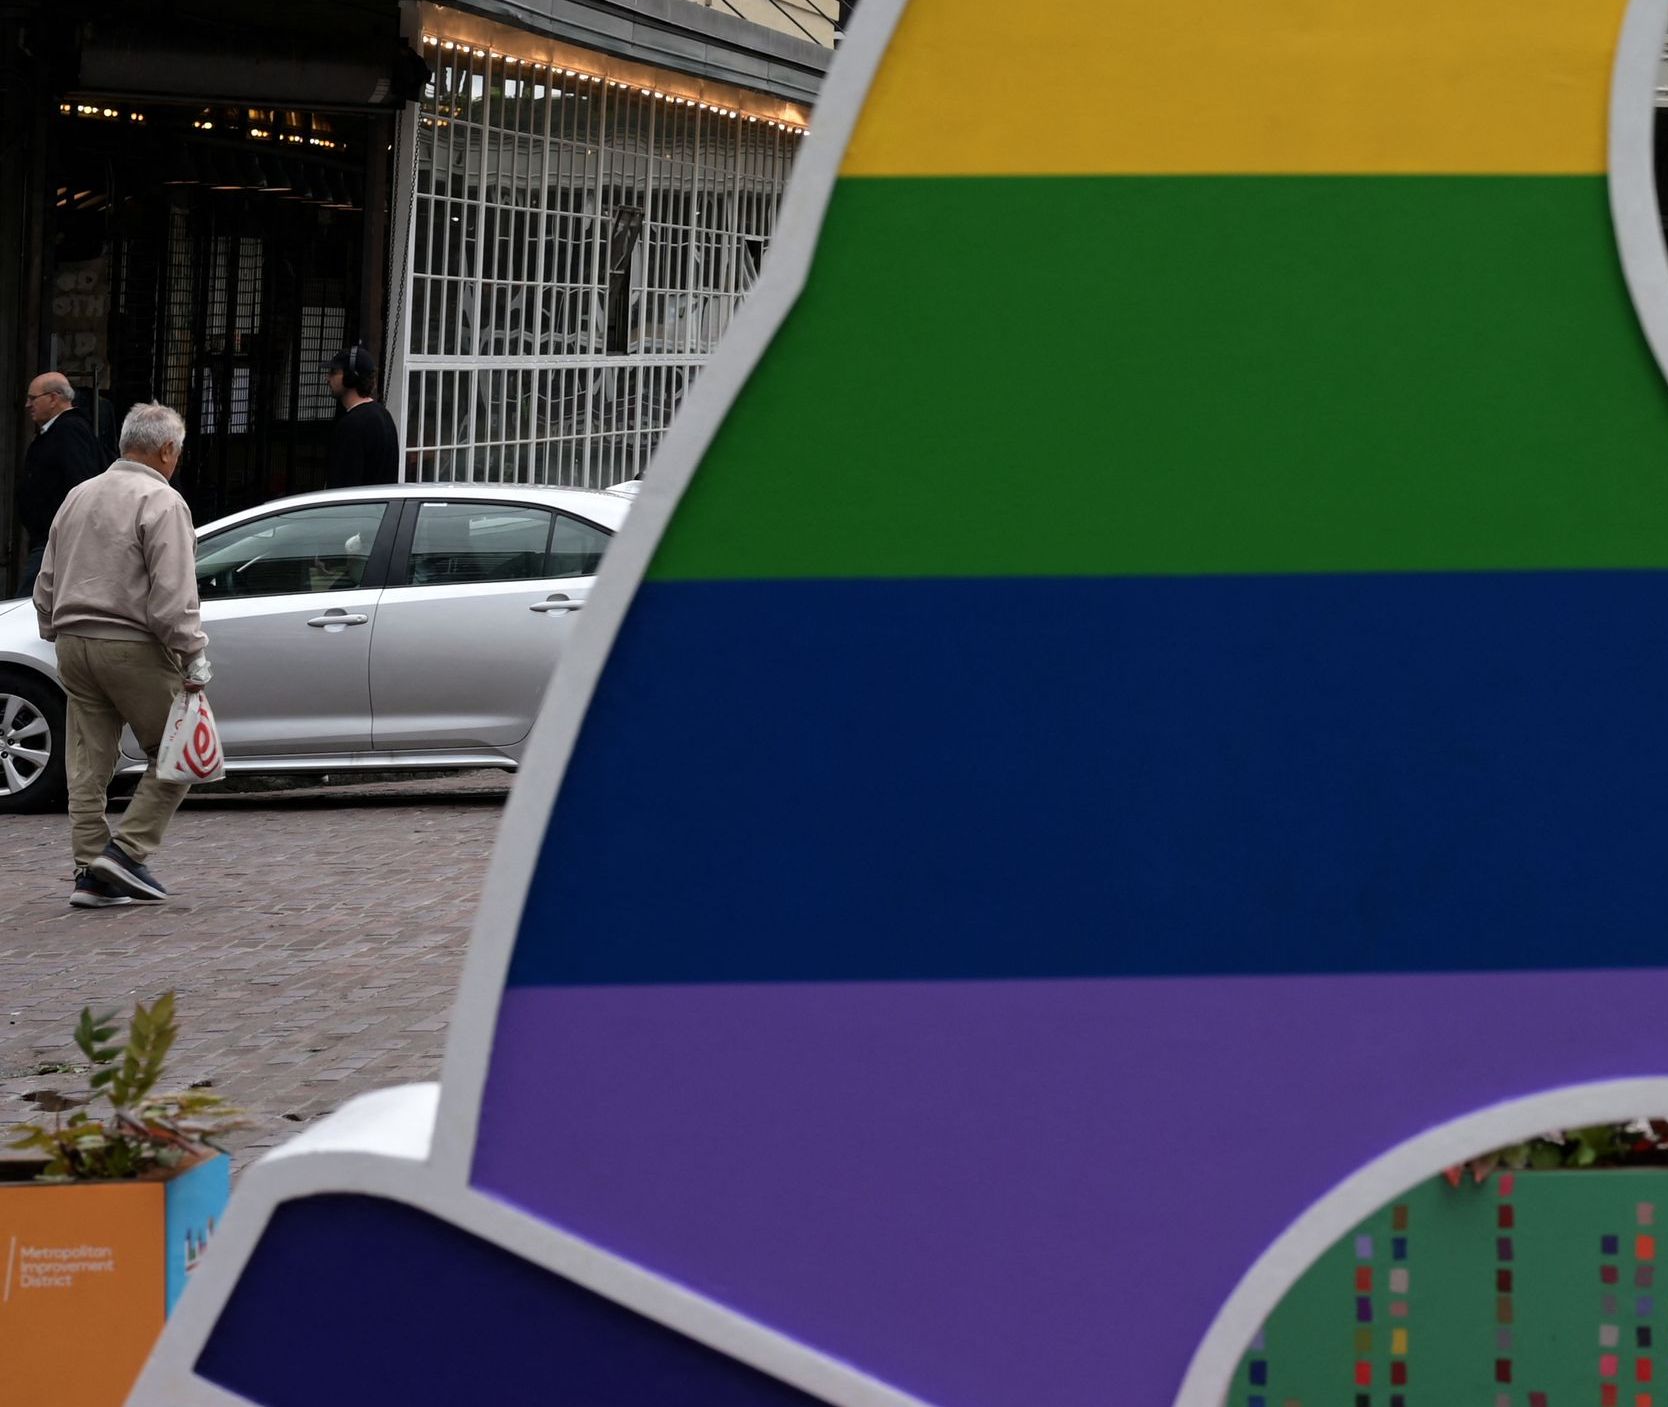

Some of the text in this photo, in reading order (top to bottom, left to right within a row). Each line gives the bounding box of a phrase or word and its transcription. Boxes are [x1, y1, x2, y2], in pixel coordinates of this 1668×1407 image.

[20, 1245, 112, 1260] Metropolitan
[21, 1260, 115, 1273] Improvement
[20, 1274, 73, 1288] District
